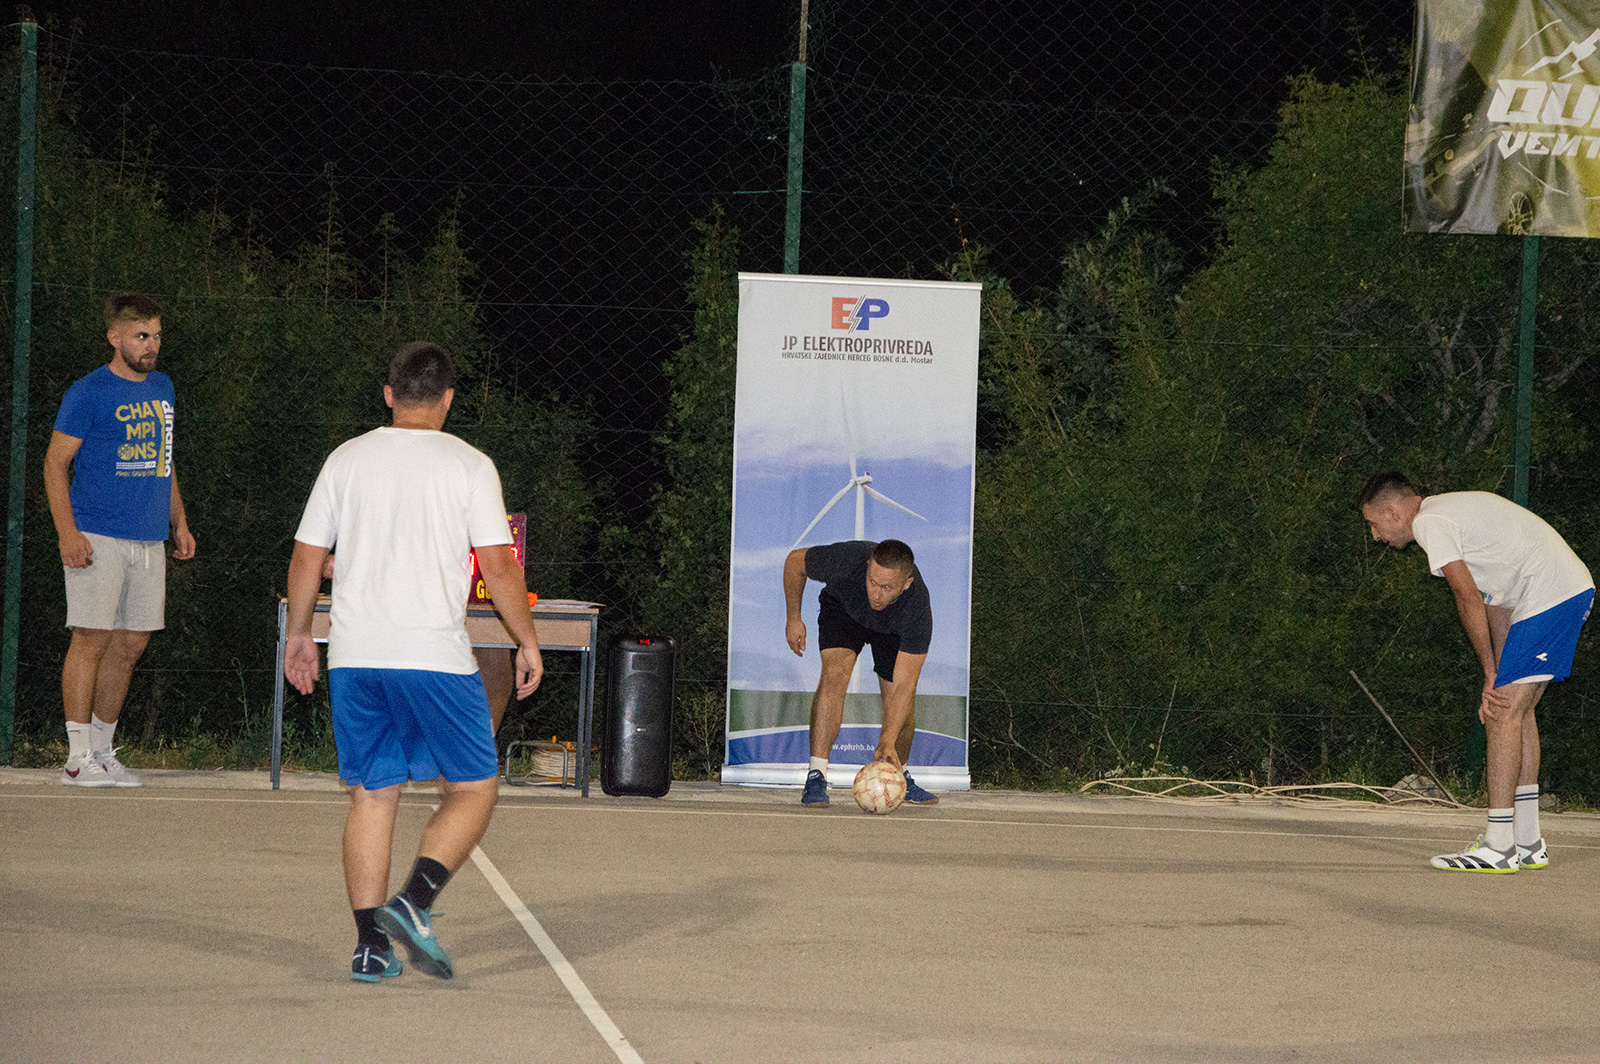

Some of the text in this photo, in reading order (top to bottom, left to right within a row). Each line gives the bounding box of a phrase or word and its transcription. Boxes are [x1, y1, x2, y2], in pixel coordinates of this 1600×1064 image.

[1497, 131, 1600, 160] VENT
[831, 296, 890, 331] EP
[782, 335, 934, 356] JP ELEKTROPRIVREDA
[781, 351, 934, 364] HRVATSKE ZAJEDNICE HERCEG BOSNE d.d. Mostar
[115, 401, 155, 422] CHA
[126, 421, 156, 440] MPI
[161, 400, 175, 478] dinamo
[832, 743, 875, 752] w.ephzhb.ba
